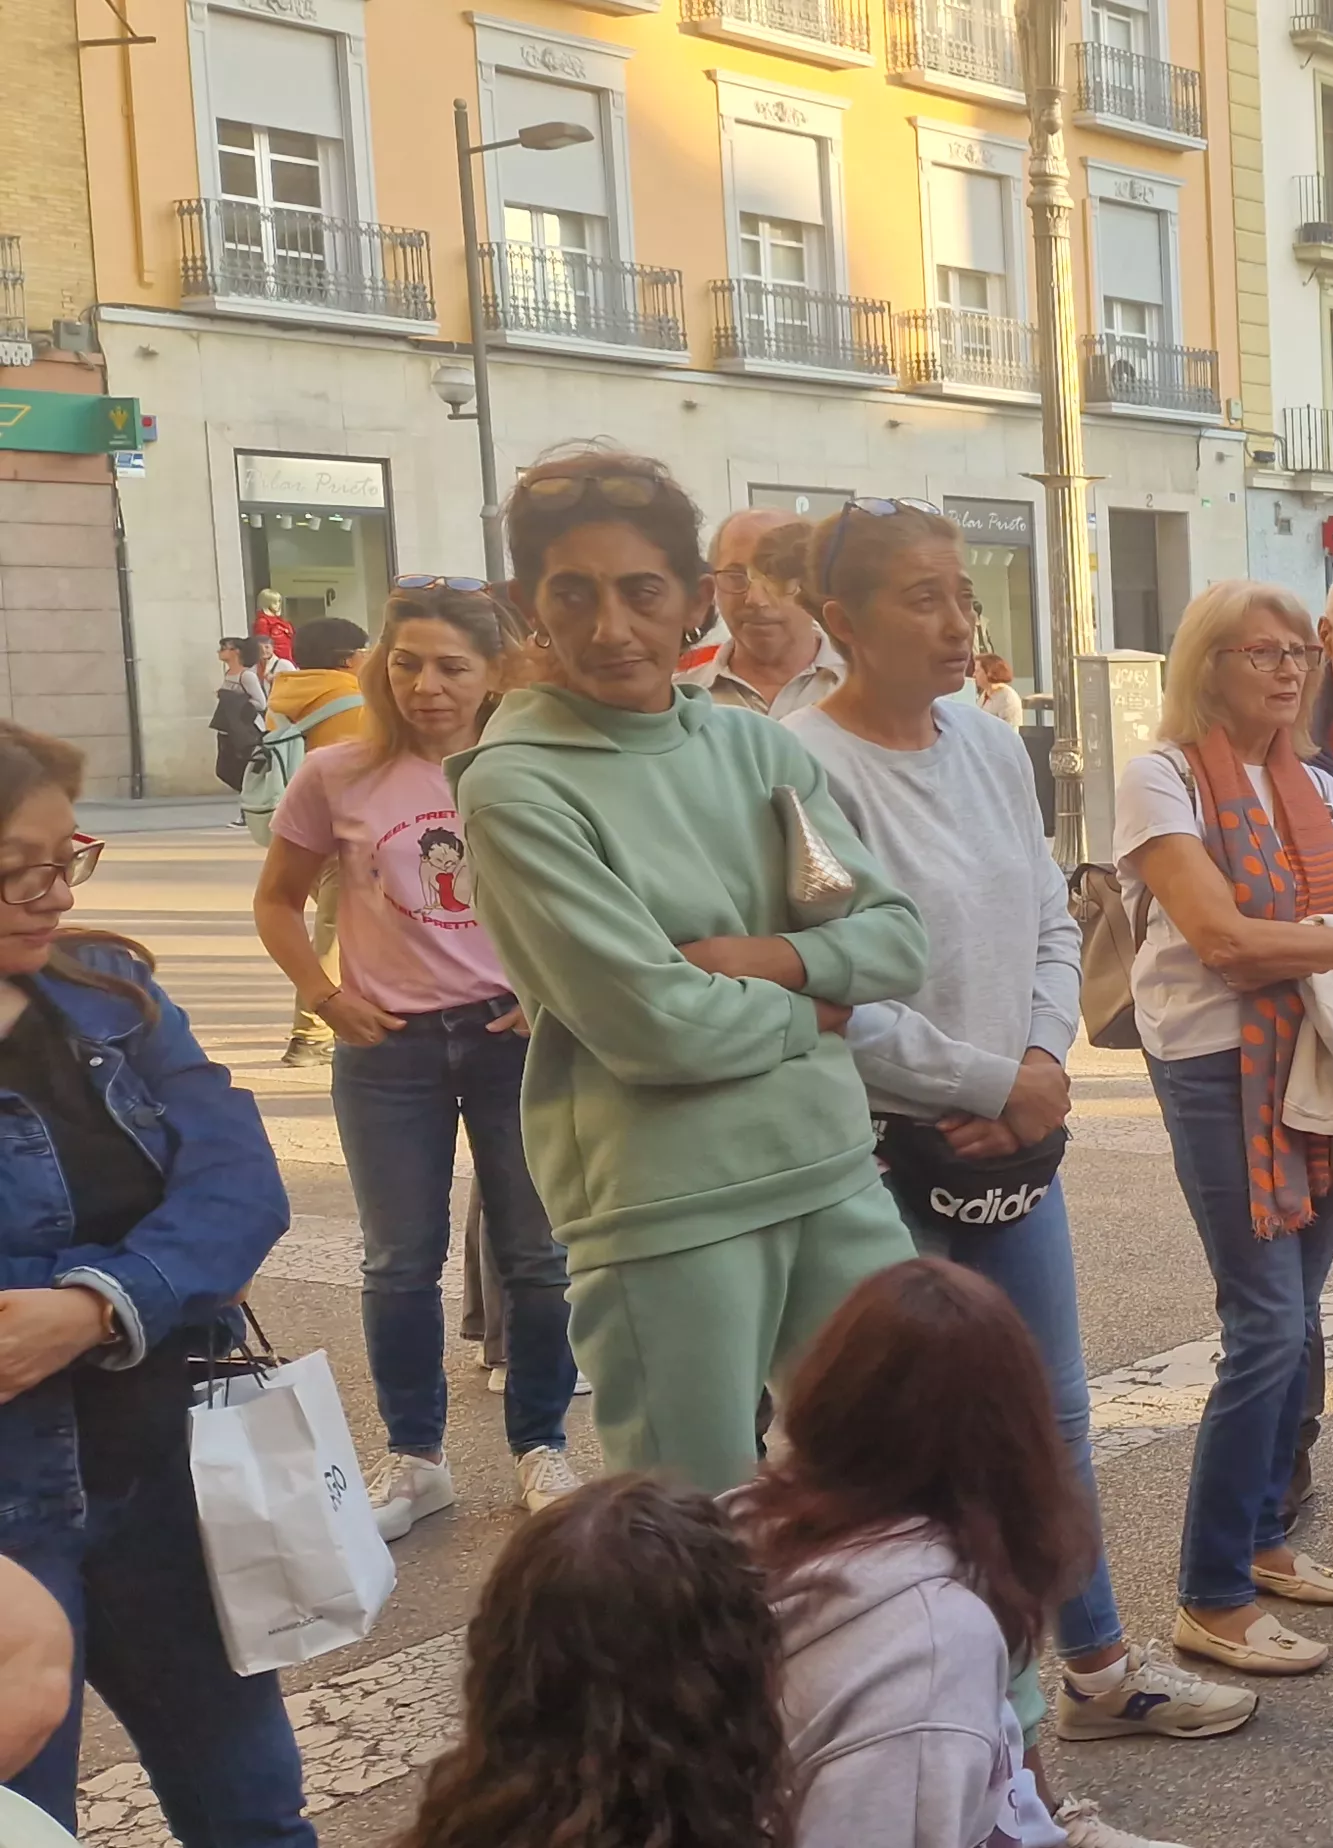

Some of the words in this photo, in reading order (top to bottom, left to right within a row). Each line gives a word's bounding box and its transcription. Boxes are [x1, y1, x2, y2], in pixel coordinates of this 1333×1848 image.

[244, 468, 305, 491] Pilar
[315, 472, 378, 496] Prieto
[948, 509, 983, 530] Pilar
[988, 512, 1027, 532] Prieto
[415, 810, 459, 823] PRET
[929, 1183, 1049, 1224] adida
